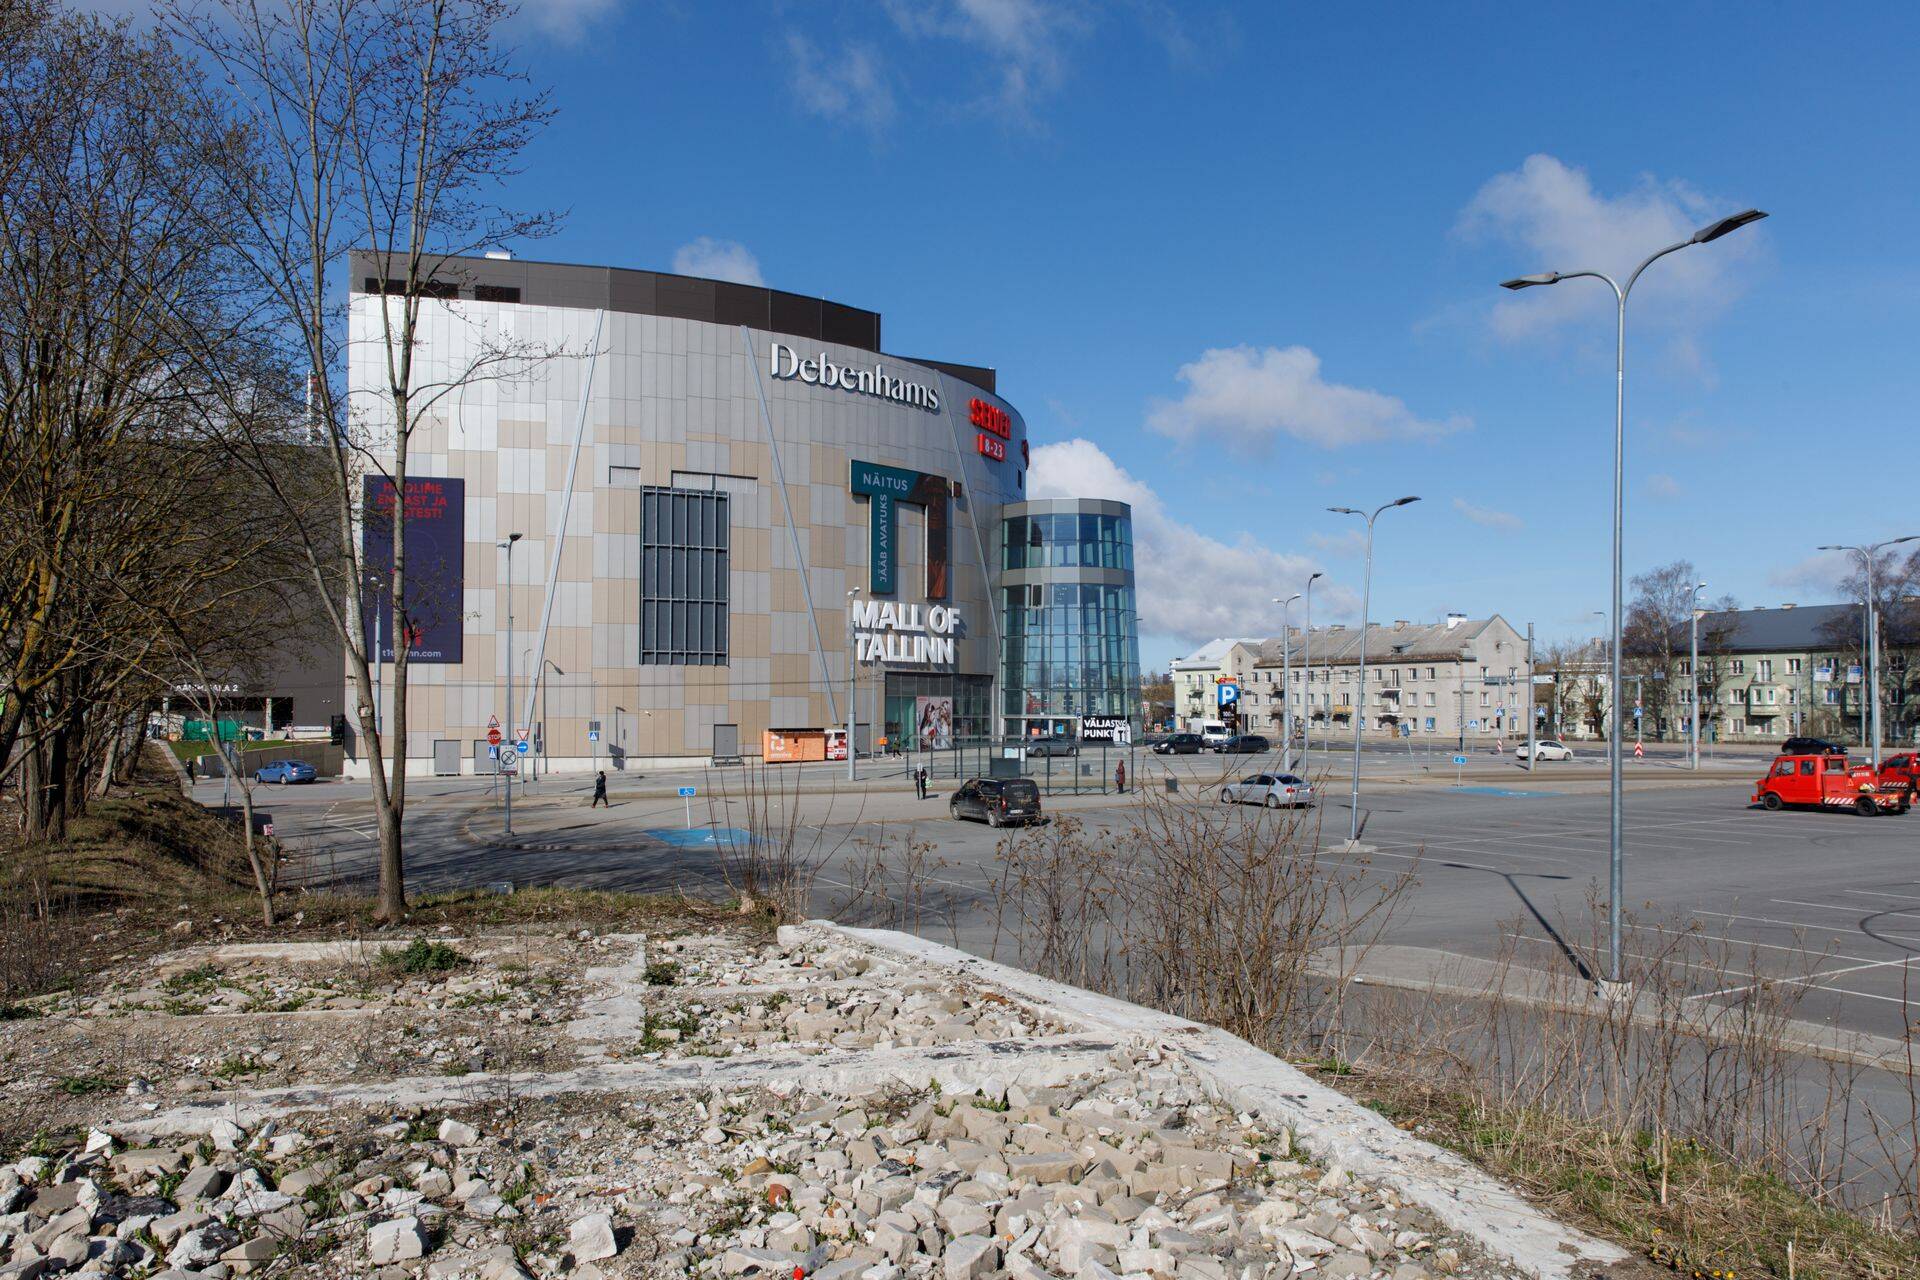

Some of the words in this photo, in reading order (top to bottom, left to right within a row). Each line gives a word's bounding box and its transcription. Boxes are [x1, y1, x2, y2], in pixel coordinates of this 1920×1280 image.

[771, 343, 938, 410] Debenhams
[970, 397, 1011, 440] SELVER
[863, 472, 909, 491] NÄITUS
[434, 496, 448, 508] JA
[879, 494, 888, 548] AVATUKS
[878, 552, 888, 583] JÄÄB
[853, 600, 925, 631] MALL
[929, 604, 961, 634] OF
[854, 632, 955, 664] TALLINN
[1222, 686, 1235, 706] P
